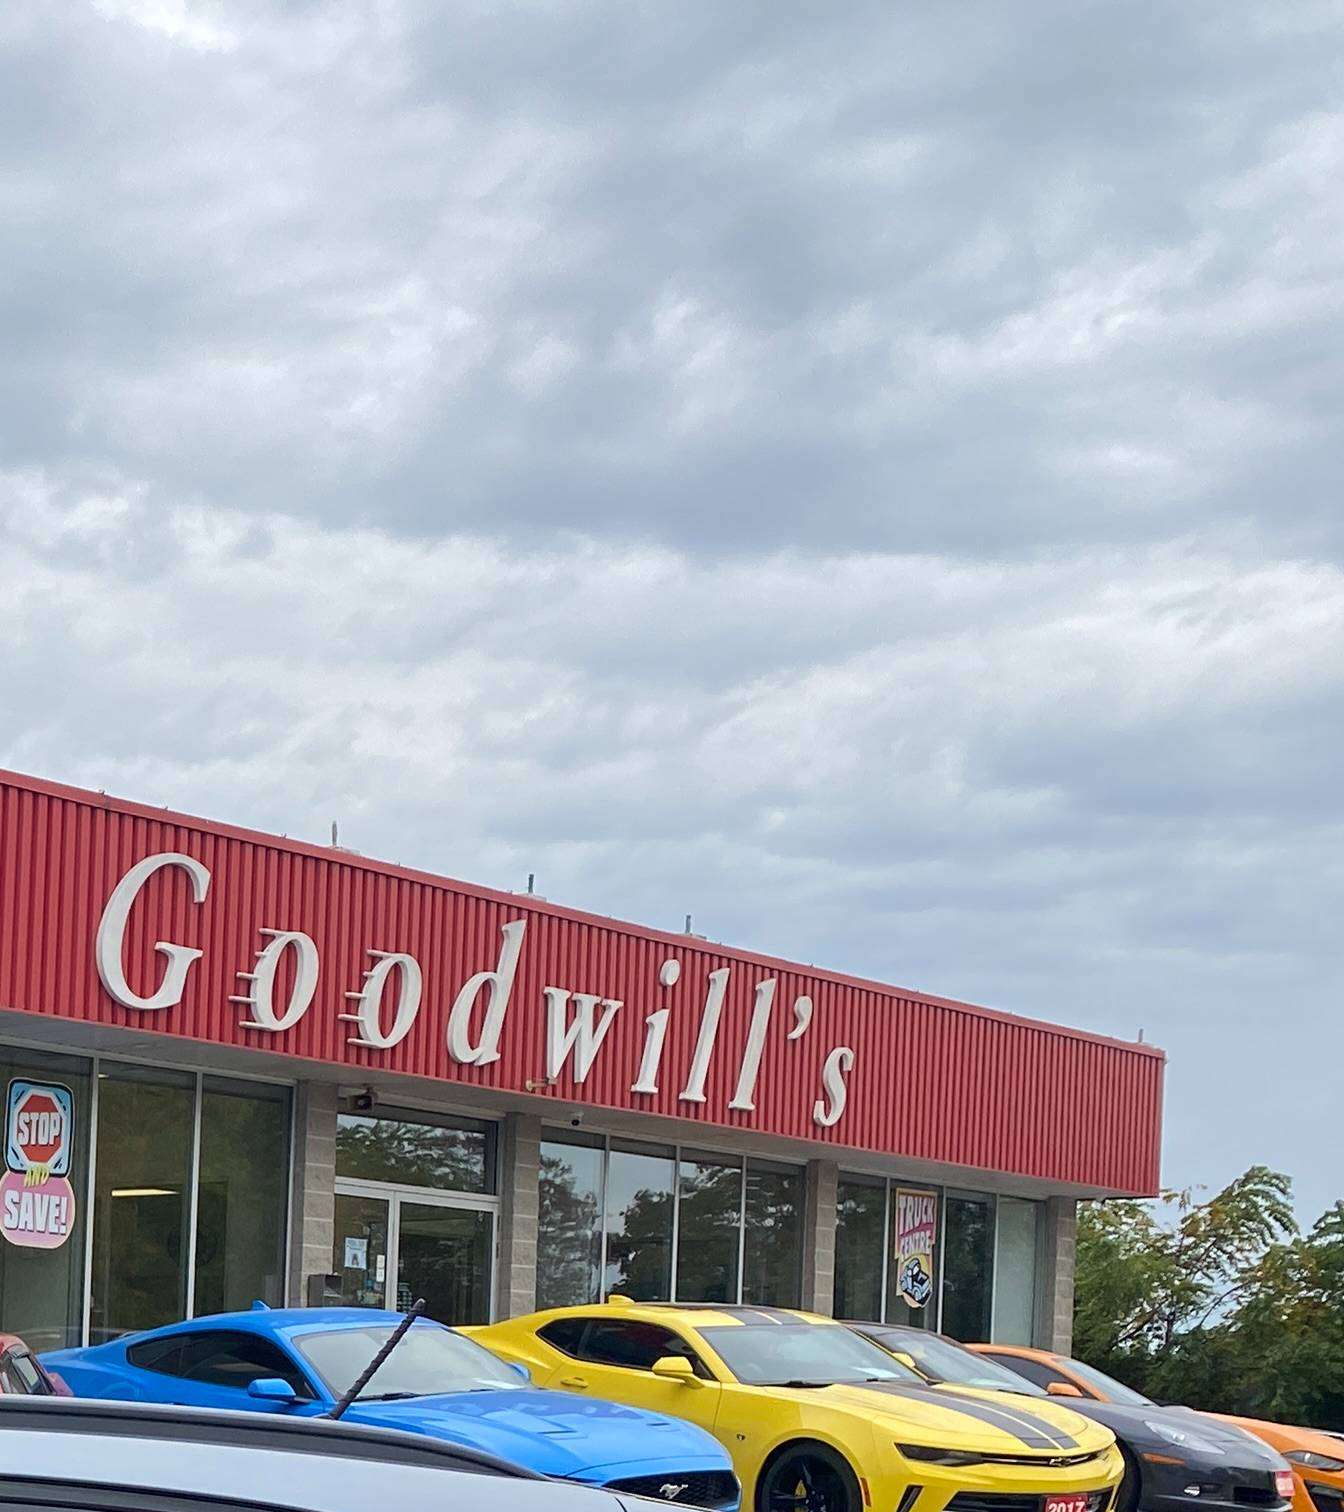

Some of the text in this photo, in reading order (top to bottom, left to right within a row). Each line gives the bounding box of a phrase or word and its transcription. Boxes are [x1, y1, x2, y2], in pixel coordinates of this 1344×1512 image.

[95, 852, 854, 1128] Goodwill's
[18, 1111, 62, 1146] STOP
[24, 1166, 50, 1188] AND
[4, 1189, 68, 1236] SAVE!
[899, 1194, 934, 1236] TRUCK
[900, 1230, 932, 1261] CENTRE
